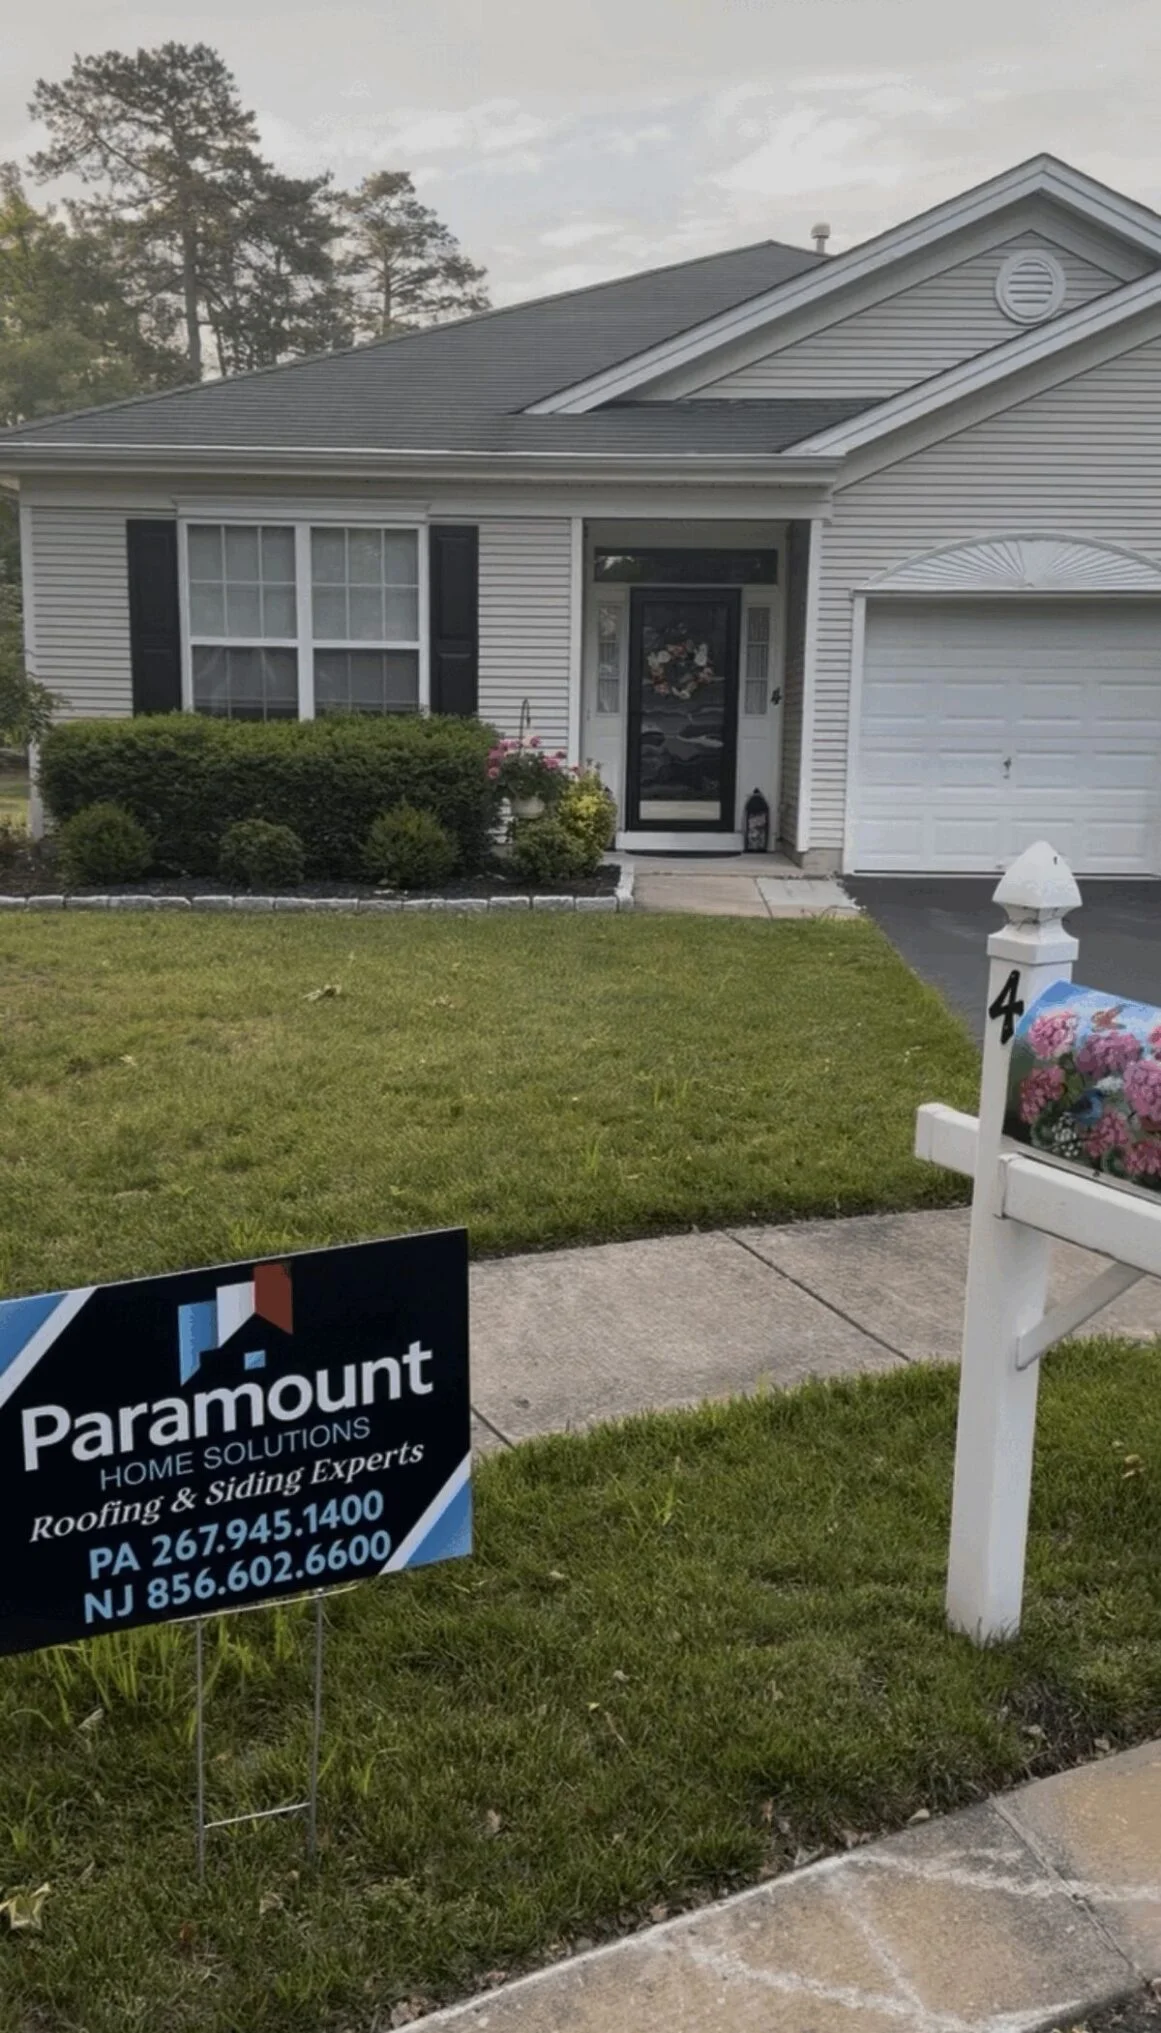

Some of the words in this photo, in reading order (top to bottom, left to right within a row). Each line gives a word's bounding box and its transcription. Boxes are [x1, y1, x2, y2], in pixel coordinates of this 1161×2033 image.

[989, 969, 1024, 1045] 4
[21, 1340, 434, 1472] Paramount
[29, 1495, 163, 1543] Roofing
[170, 1485, 198, 1513] &
[205, 1467, 304, 1506] Siding
[310, 1440, 425, 1484] Experts
[100, 1451, 194, 1491] HOME
[203, 1416, 371, 1470] SOLUTIONS
[84, 1586, 136, 1624] NJ
[146, 1530, 392, 1611] 856.602.6600
[89, 1543, 141, 1580] PA
[151, 1490, 385, 1568] 267.945.1400
